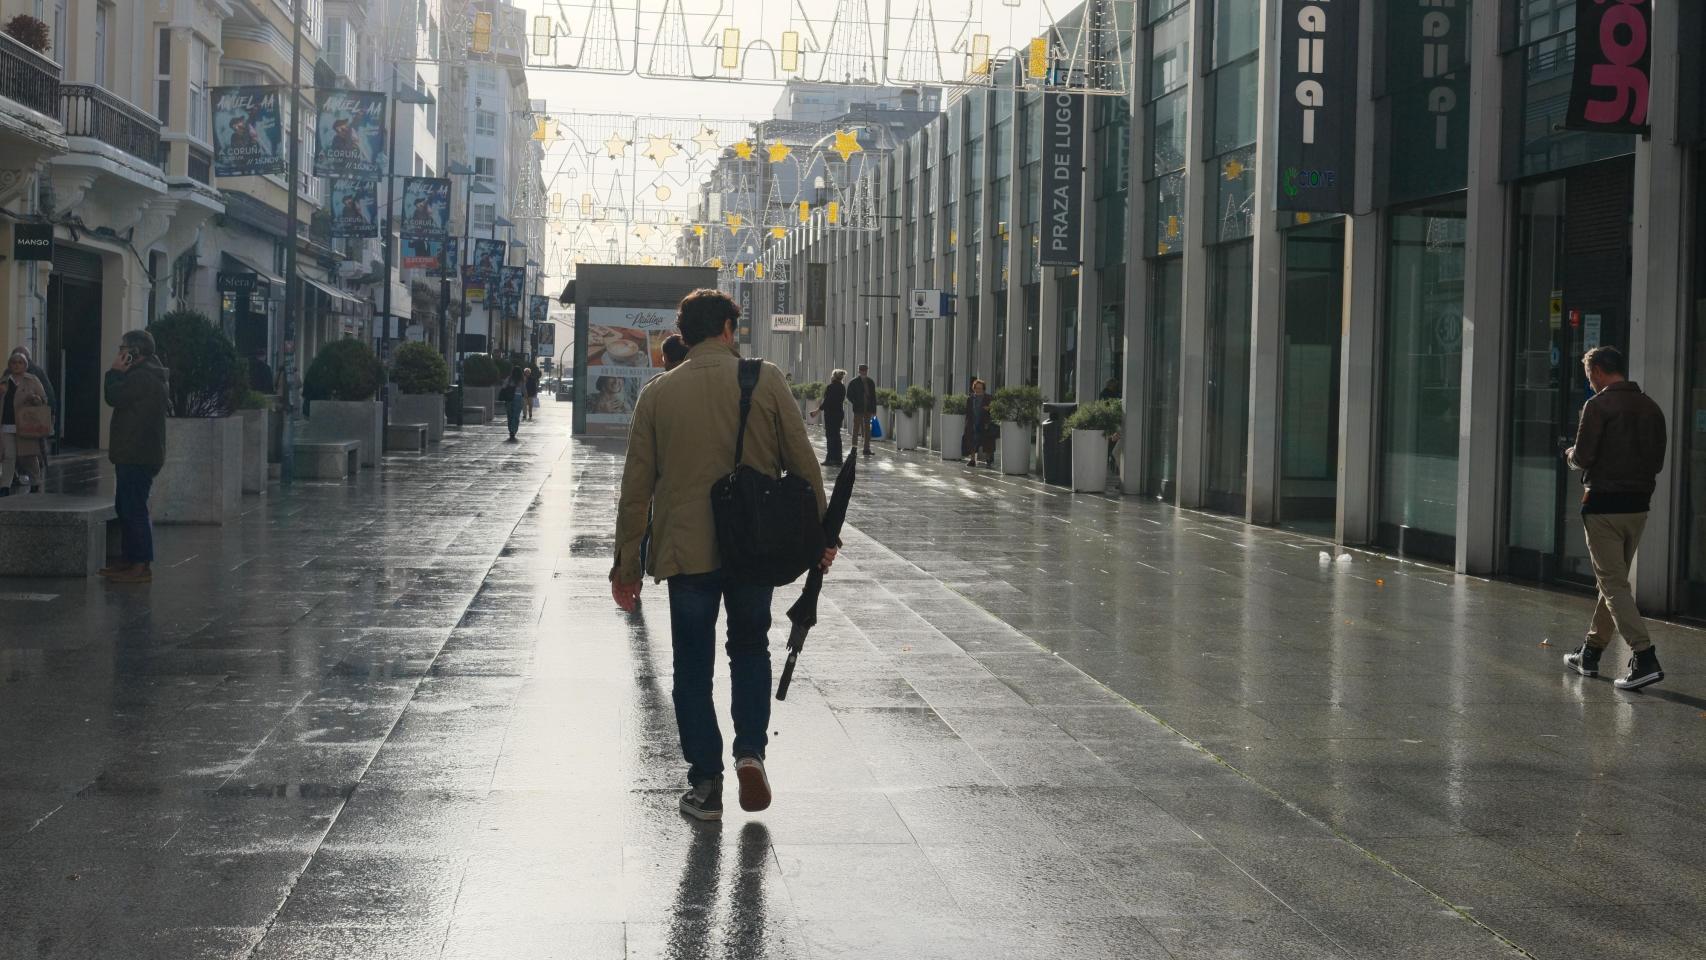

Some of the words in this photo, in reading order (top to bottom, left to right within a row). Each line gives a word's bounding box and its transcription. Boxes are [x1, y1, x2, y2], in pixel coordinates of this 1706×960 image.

[1584, 0, 1649, 126] yo
[1055, 91, 1072, 148] LUGO
[1054, 154, 1070, 180] DE
[1052, 185, 1069, 250] PRAZA
